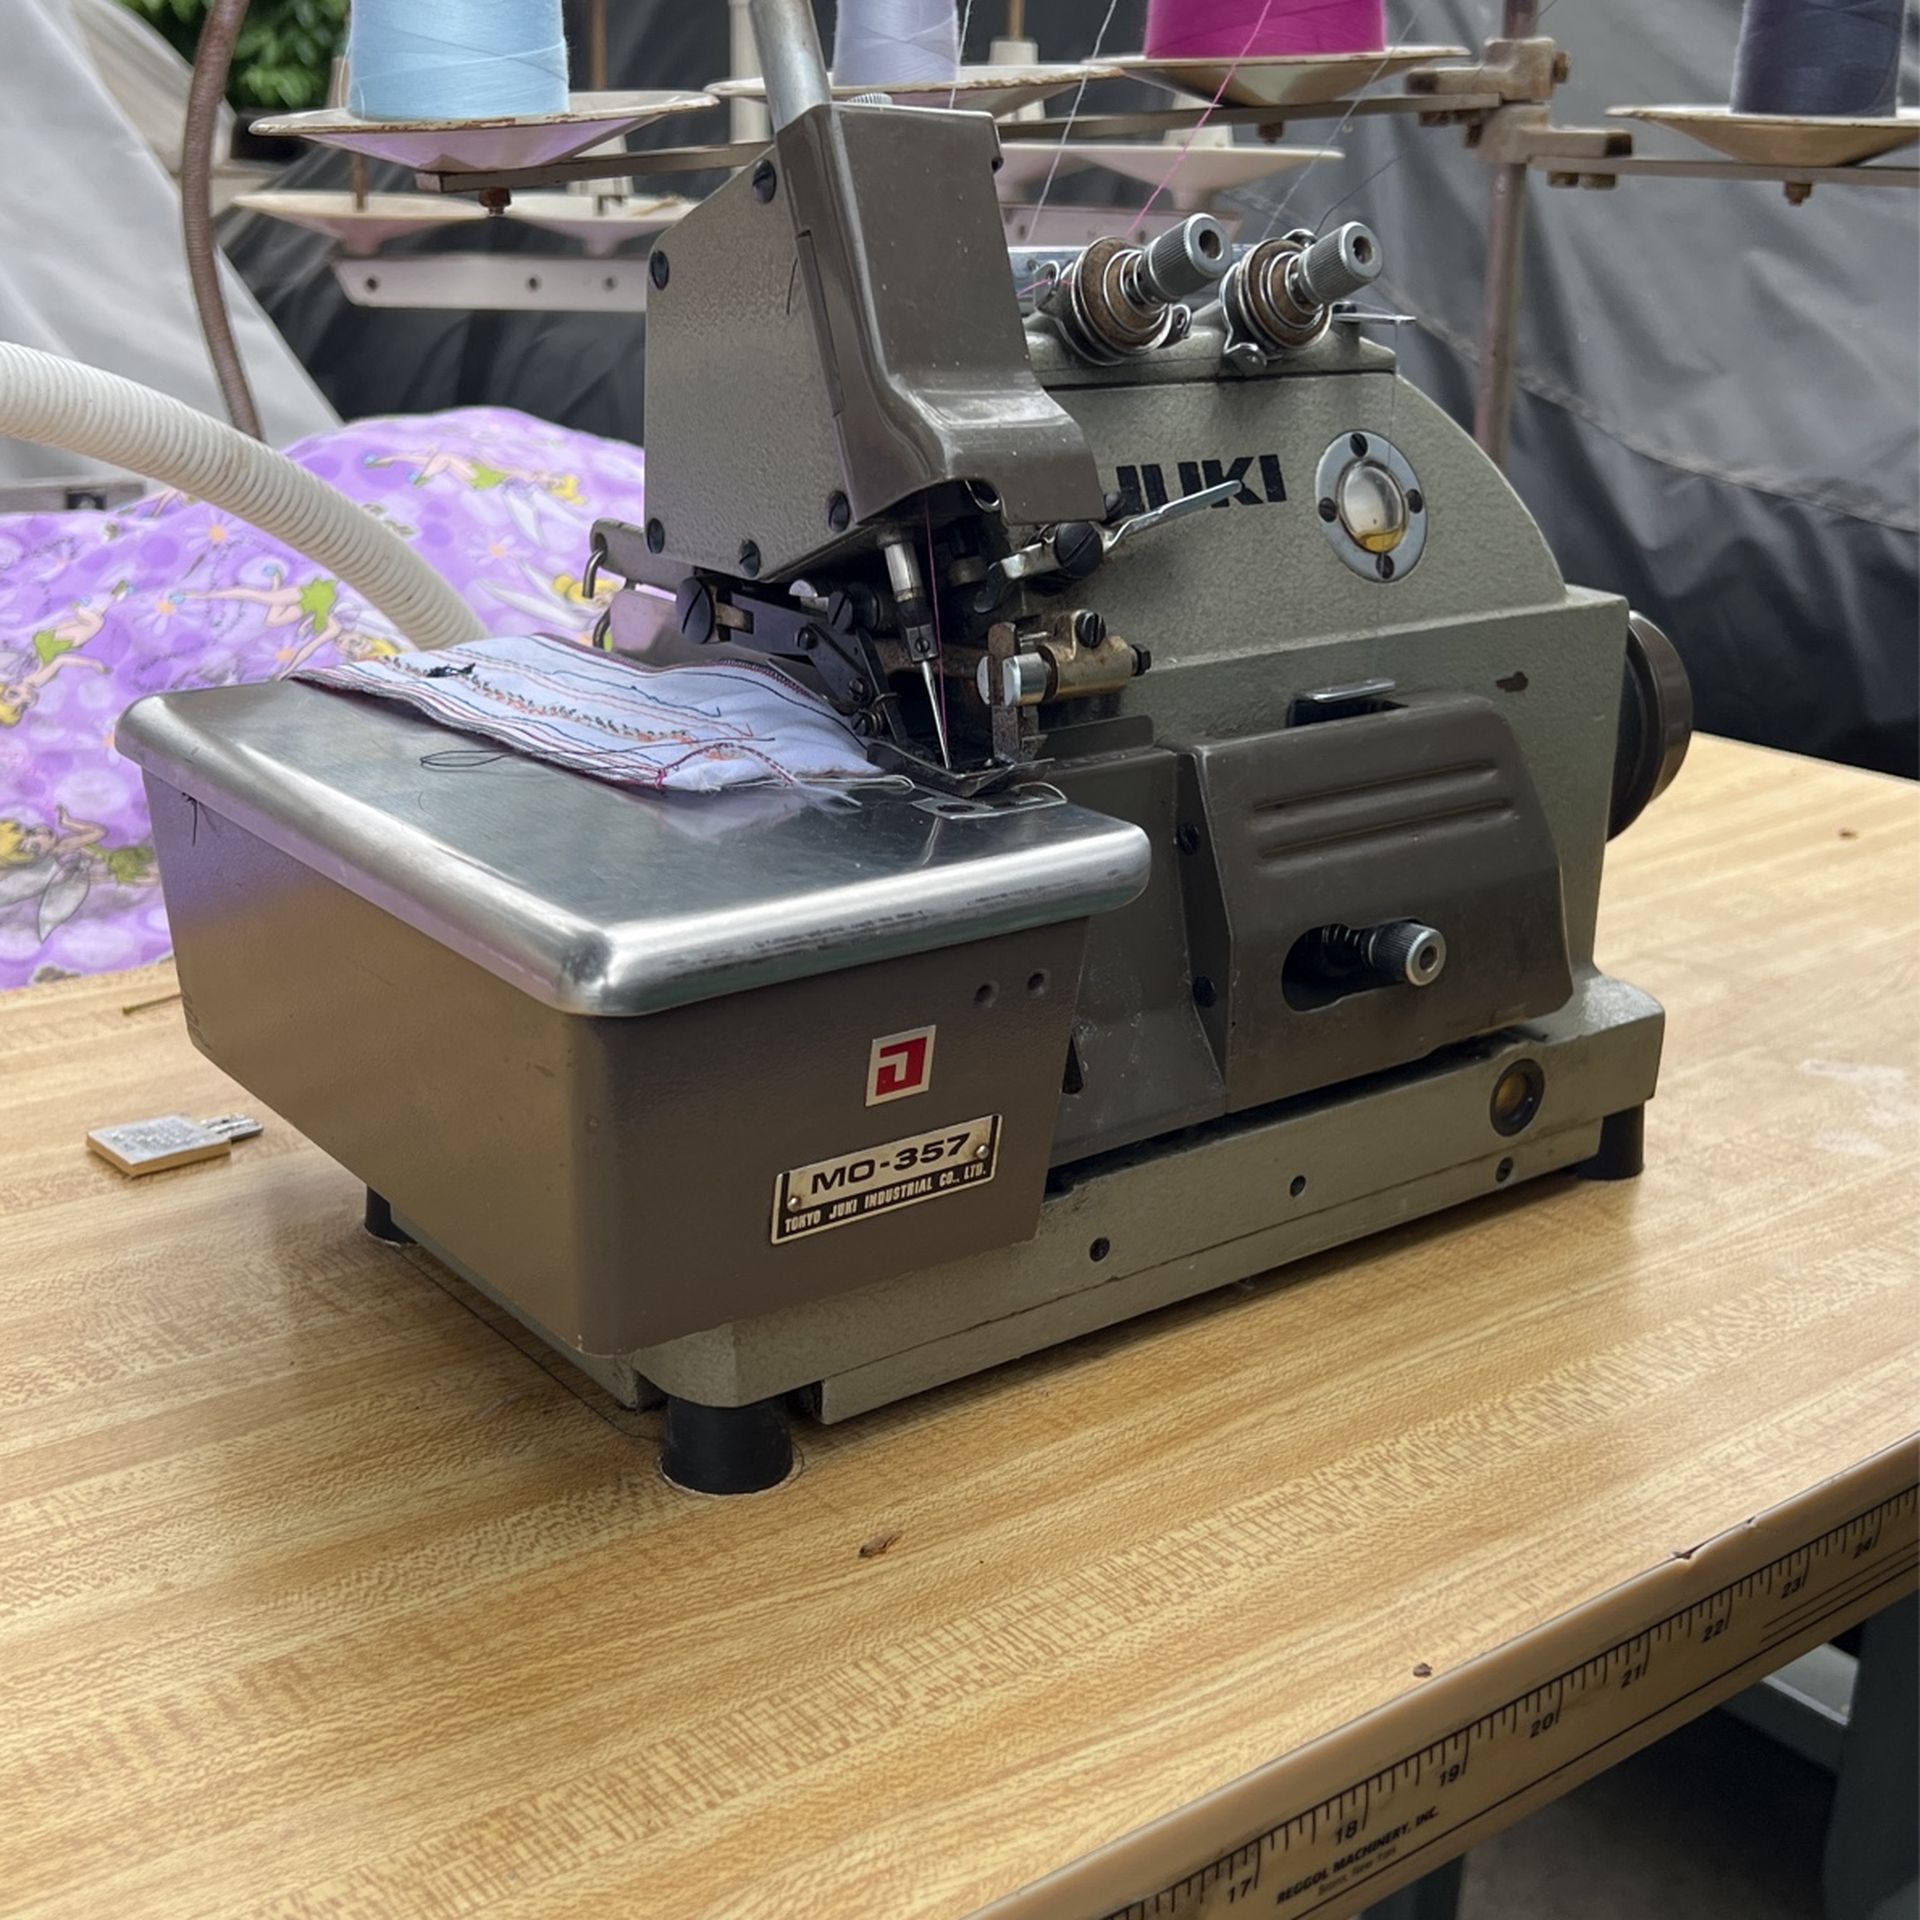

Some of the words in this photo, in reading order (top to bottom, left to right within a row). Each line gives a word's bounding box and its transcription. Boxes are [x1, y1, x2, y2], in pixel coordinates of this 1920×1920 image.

[811, 1132, 971, 1194] MO-357
[785, 1209, 821, 1233] TOKYO
[829, 1199, 857, 1220] JUKI
[864, 1177, 933, 1209] INDUSTRIAL
[964, 1162, 987, 1180] LTD.
[1781, 1577, 1801, 1599] 23
[1702, 1619, 1724, 1642] 22
[1621, 1664, 1642, 1688] 21
[1529, 1712, 1554, 1738] 20
[1439, 1764, 1460, 1787] 19
[1336, 1820, 1358, 1844] 18
[1228, 1877, 1252, 1903] 17
